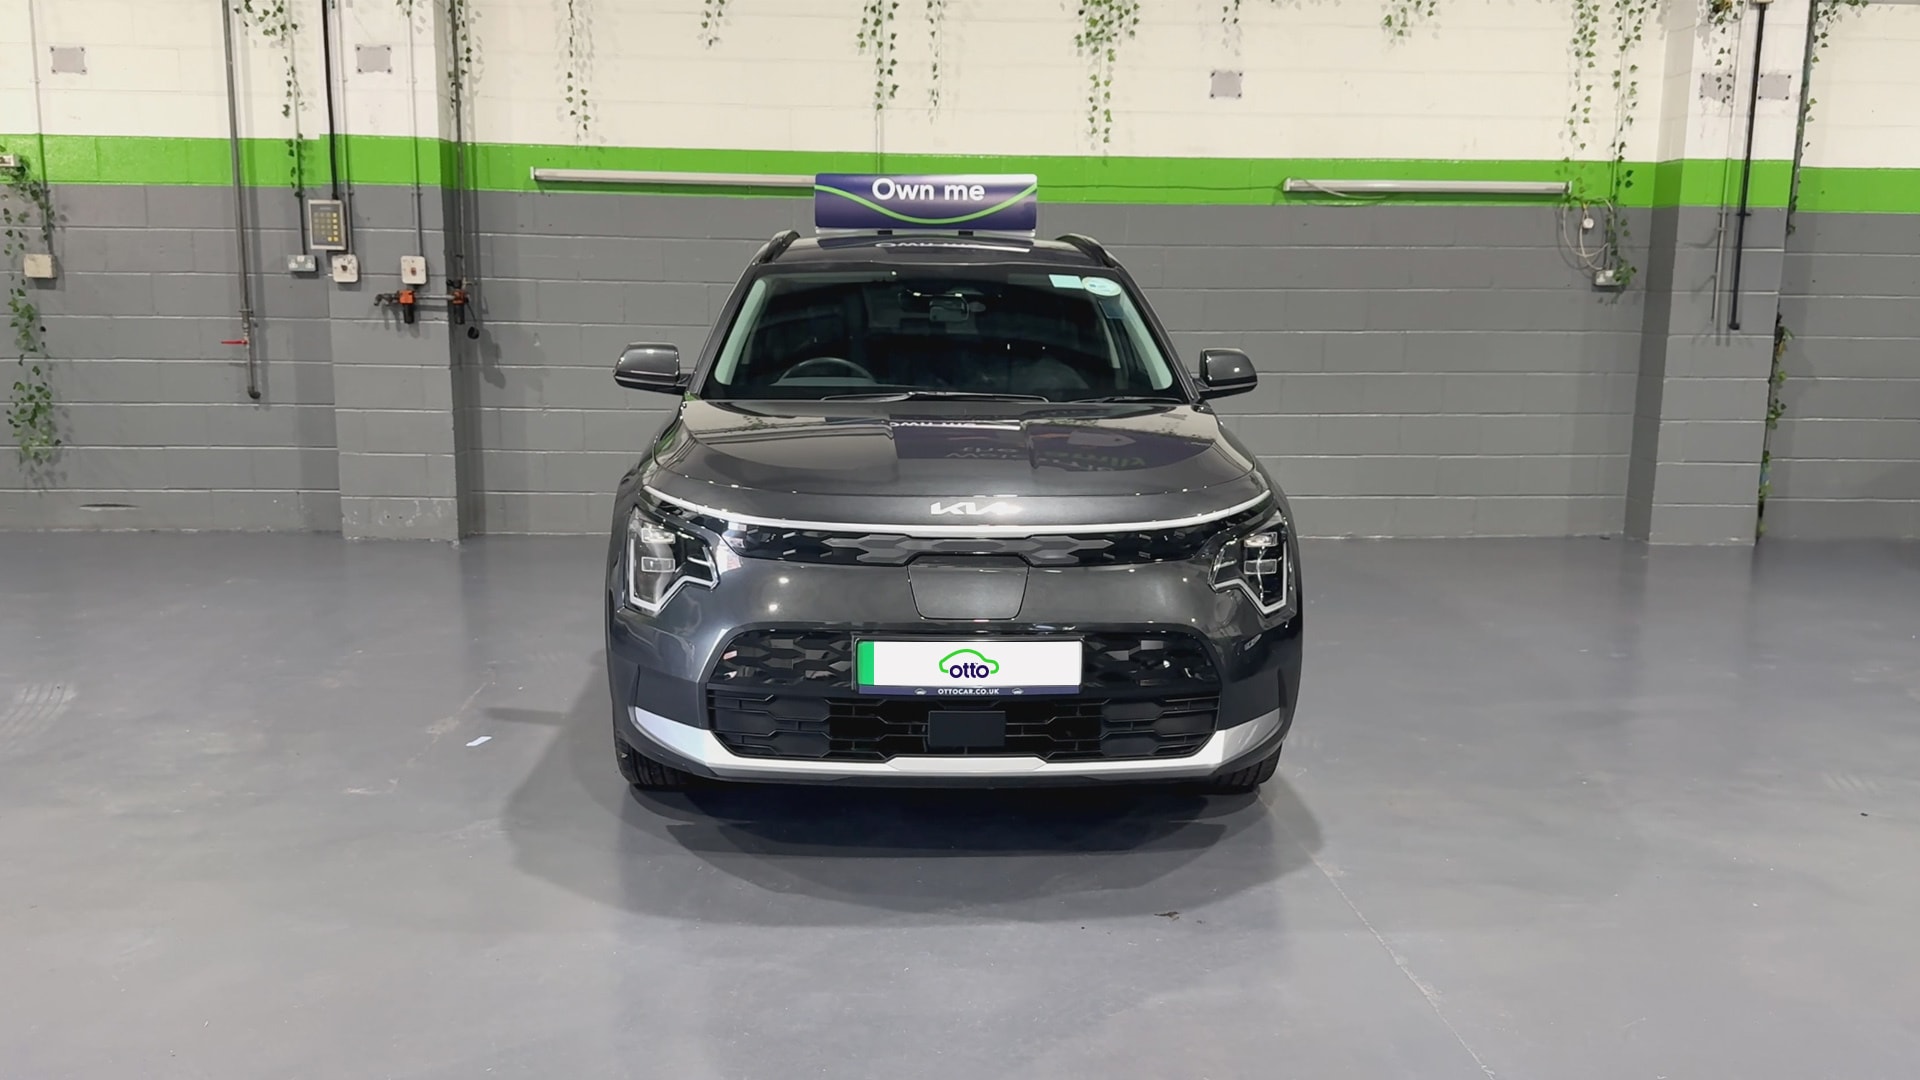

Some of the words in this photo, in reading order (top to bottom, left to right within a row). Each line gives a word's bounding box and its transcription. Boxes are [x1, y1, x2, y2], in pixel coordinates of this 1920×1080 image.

[872, 177, 934, 201] Own
[944, 184, 985, 201] me
[949, 662, 990, 679] otto
